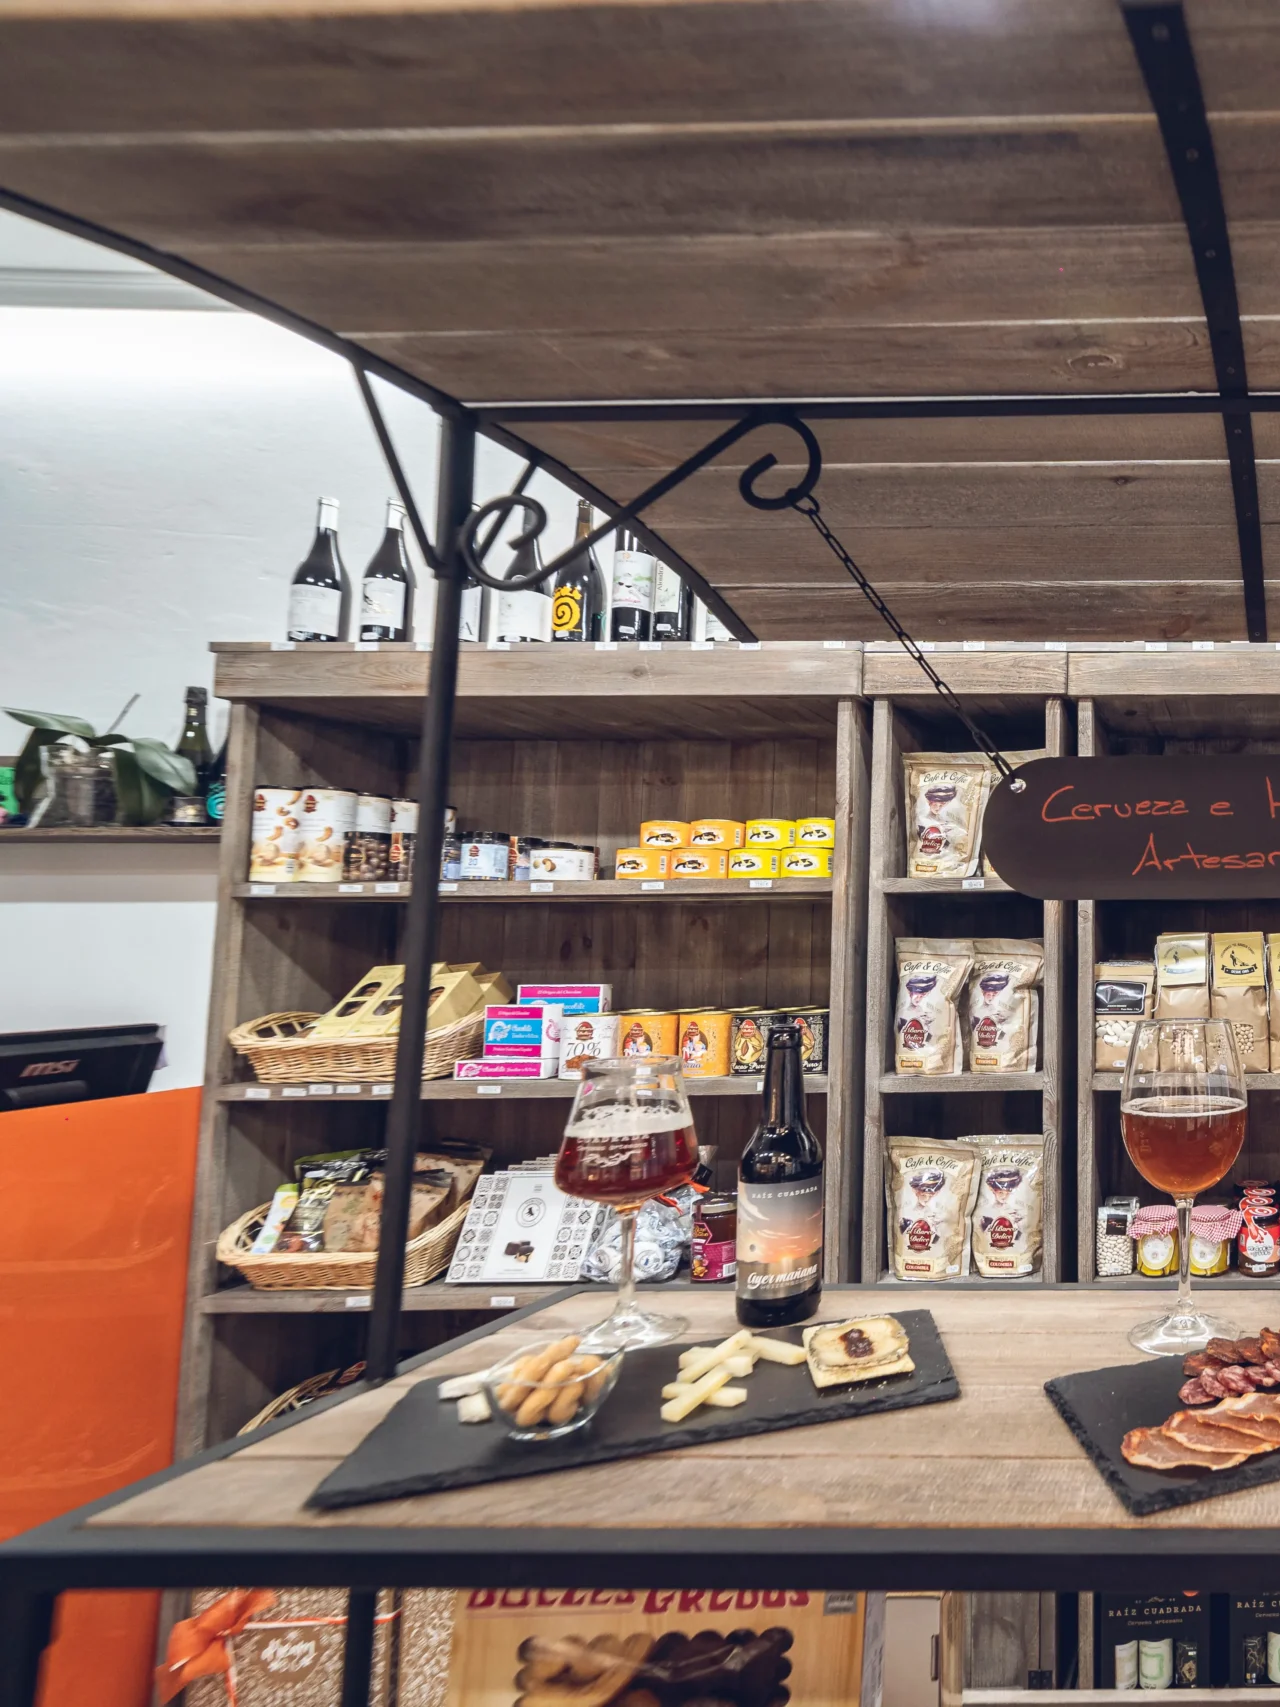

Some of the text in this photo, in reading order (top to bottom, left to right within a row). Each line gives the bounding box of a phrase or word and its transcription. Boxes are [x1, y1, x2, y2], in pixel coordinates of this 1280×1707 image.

[1041, 785, 1190, 823] Cerveza
[1209, 800, 1235, 817] e
[904, 1155, 959, 1170] Café & Coffee
[1108, 1604, 1203, 1617] RAÍZ CUADRADA
[1236, 1599, 1266, 1609] RAÍZ
